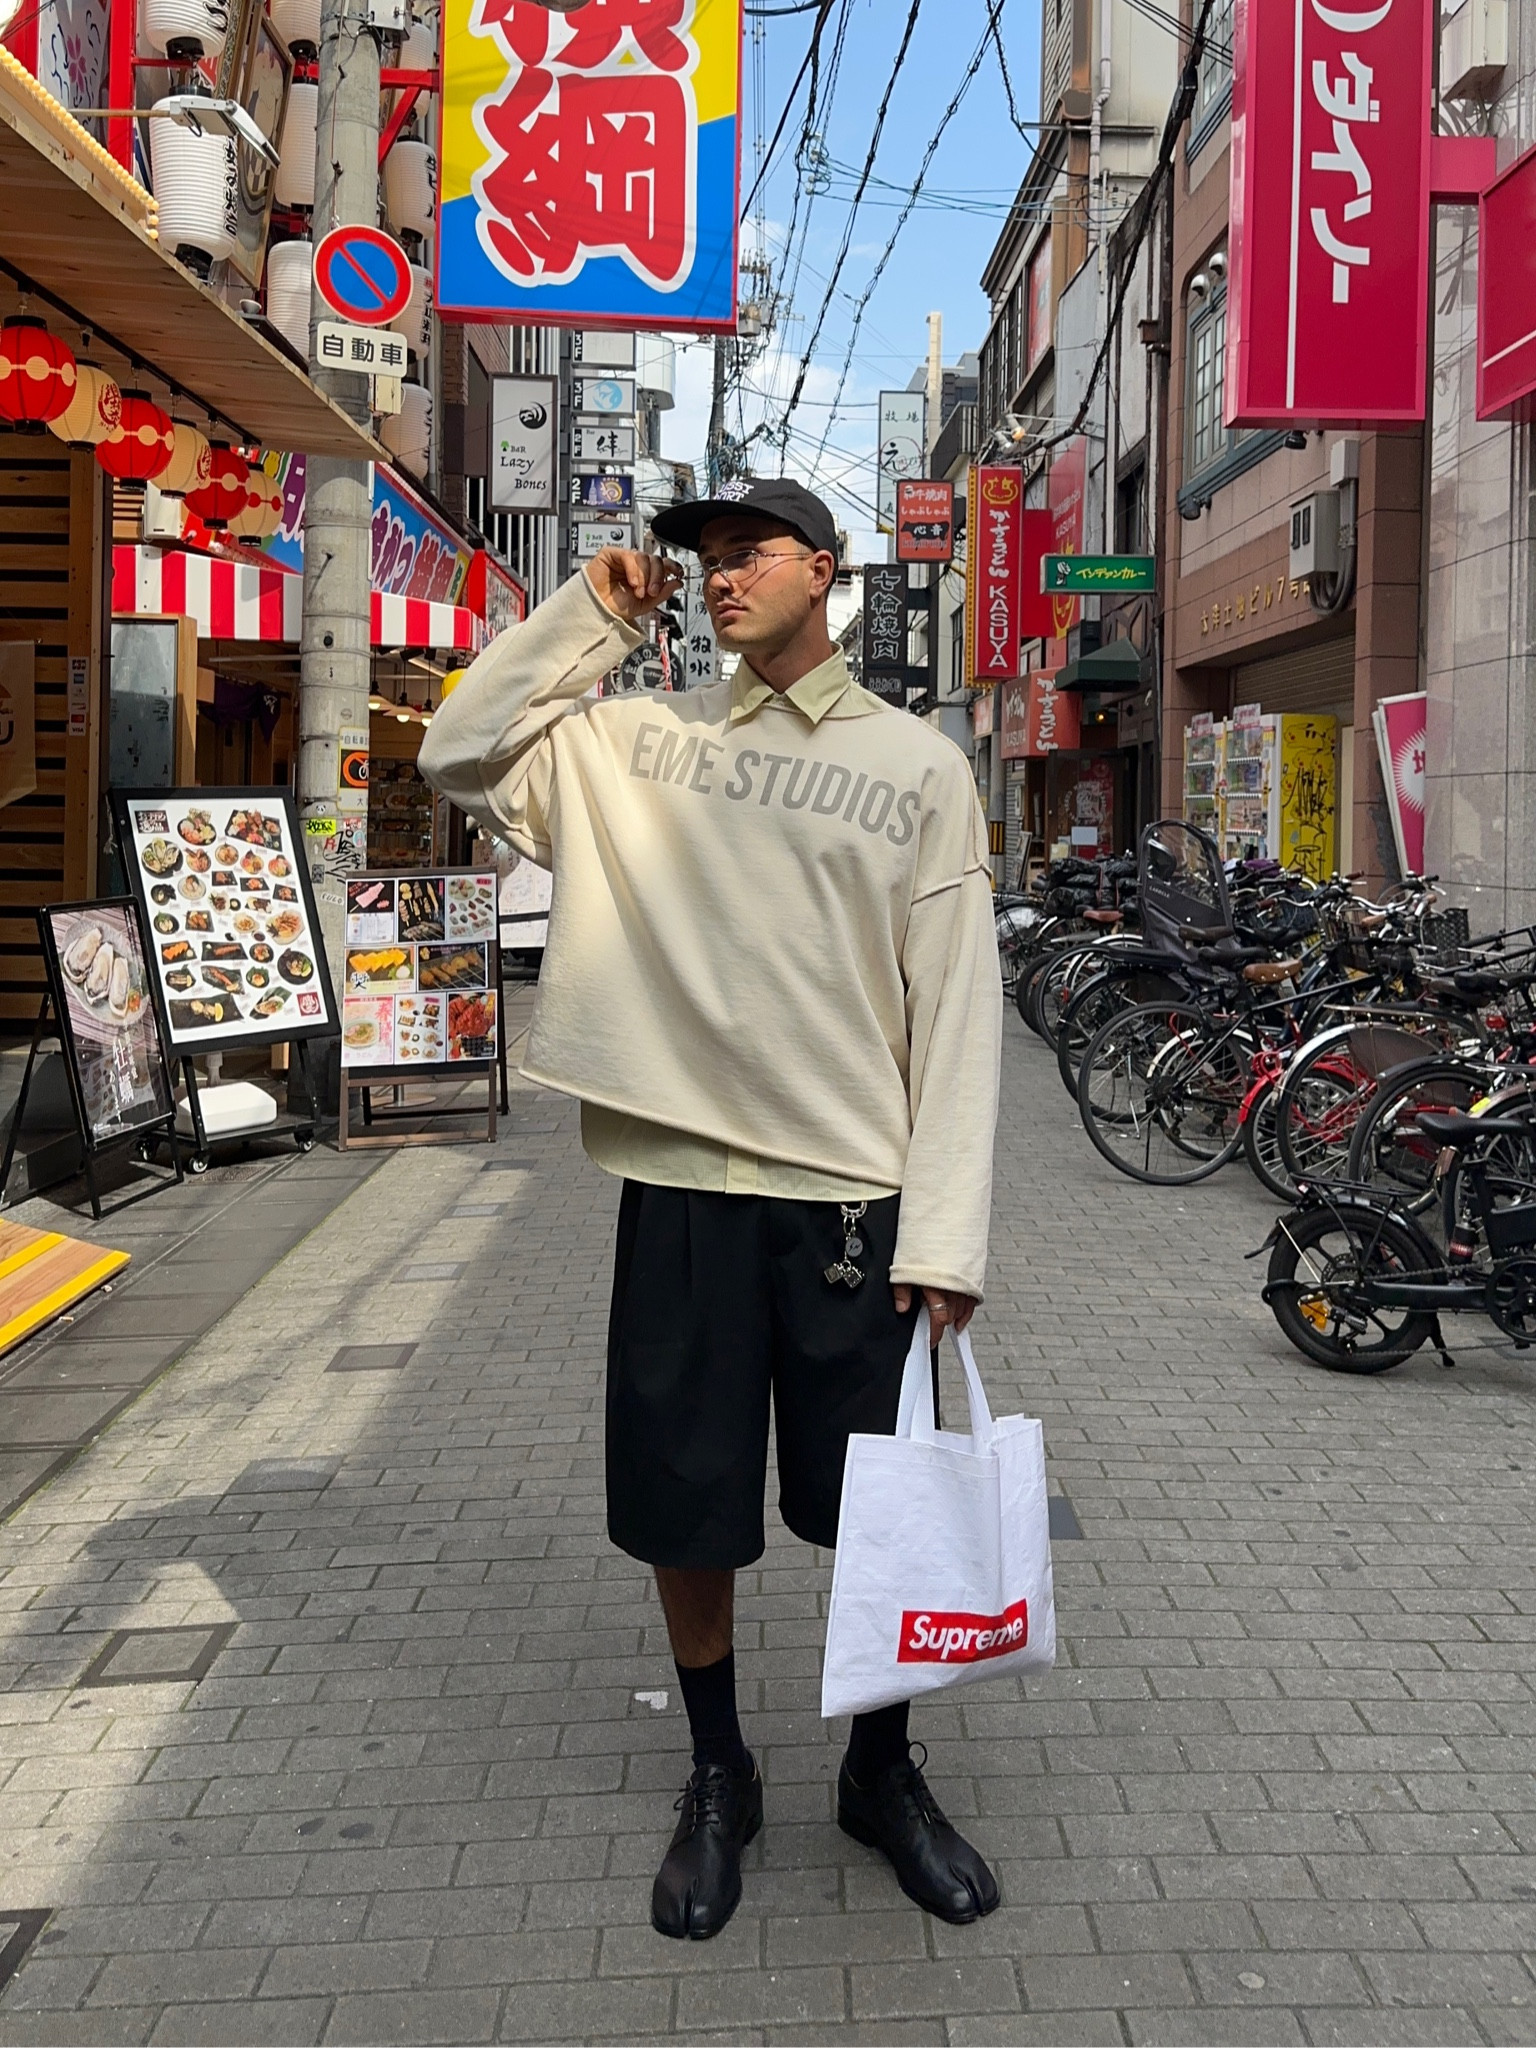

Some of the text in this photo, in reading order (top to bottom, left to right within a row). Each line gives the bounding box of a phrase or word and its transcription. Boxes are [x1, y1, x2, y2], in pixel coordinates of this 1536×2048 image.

[1310, 51, 1380, 304] ダイソー
[322, 333, 404, 367] 自動車
[575, 334, 583, 358] 3F
[574, 382, 583, 407] 3F
[500, 456, 535, 475] Lazy
[514, 478, 547, 491] Bones
[571, 477, 581, 504] 2F
[903, 485, 948, 502] 和牛焼肉
[901, 506, 950, 517] しゃぶしゃぶ
[988, 509, 1011, 579] かすうどん
[870, 570, 903, 661] 七輪焼肉
[988, 585, 1010, 669] KASUYA
[629, 721, 921, 847] EME STUDIOS
[908, 1615, 1024, 1660] Supreme
